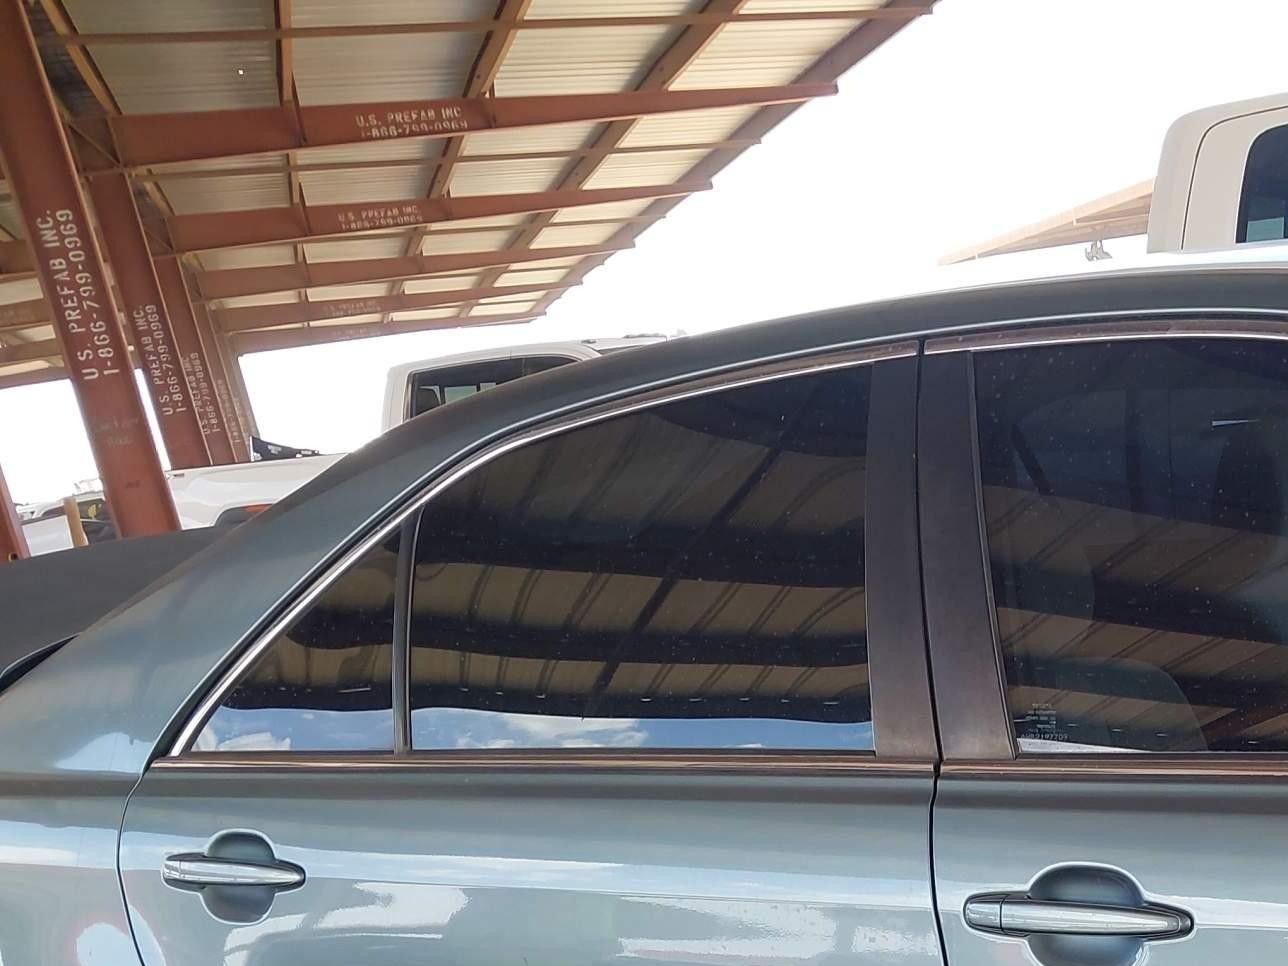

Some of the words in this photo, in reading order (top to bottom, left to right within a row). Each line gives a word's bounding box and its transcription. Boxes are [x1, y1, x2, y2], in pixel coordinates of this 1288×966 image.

[35, 209, 61, 249] INC.
[49, 257, 87, 333] PREFAB
[55, 208, 120, 376] 1-866-799-0969
[140, 335, 166, 385] PREFAB
[144, 304, 188, 413] 1-866-799-0969
